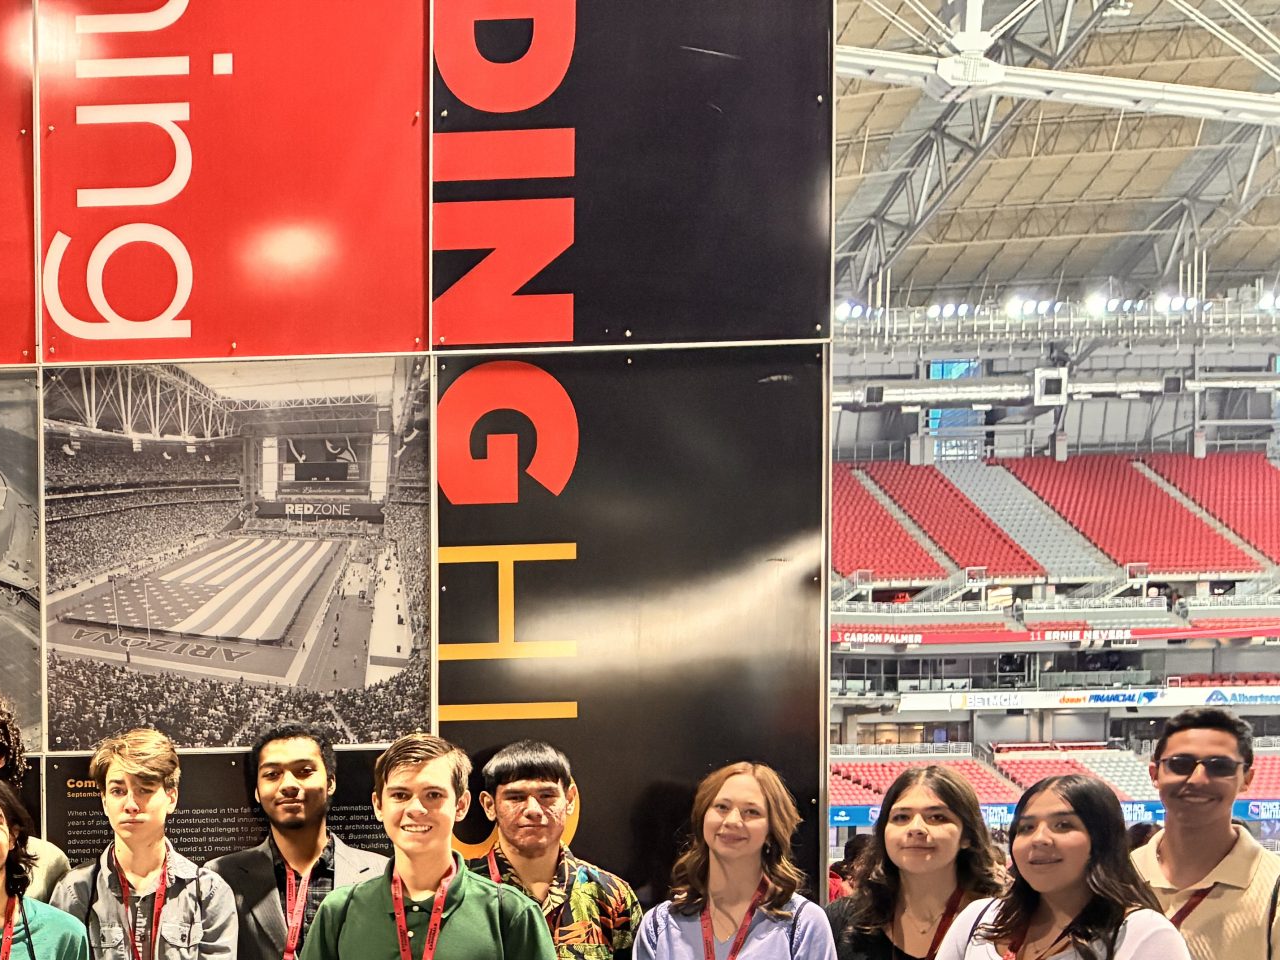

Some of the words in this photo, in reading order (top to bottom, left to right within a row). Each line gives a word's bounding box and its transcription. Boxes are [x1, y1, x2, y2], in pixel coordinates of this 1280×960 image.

[285, 503, 351, 515] REDZONE
[844, 632, 882, 643] CARSON
[884, 633, 923, 644] PALMER
[1030, 631, 1041, 641] 11
[1045, 630, 1080, 641] ERNIE
[1083, 629, 1132, 641] NEVERS
[72, 628, 254, 663] ARIZONA
[1088, 693, 1136, 703] FINANCIAL
[191, 807, 218, 815] opened
[202, 825, 239, 833] challenges
[360, 841, 389, 850] building
